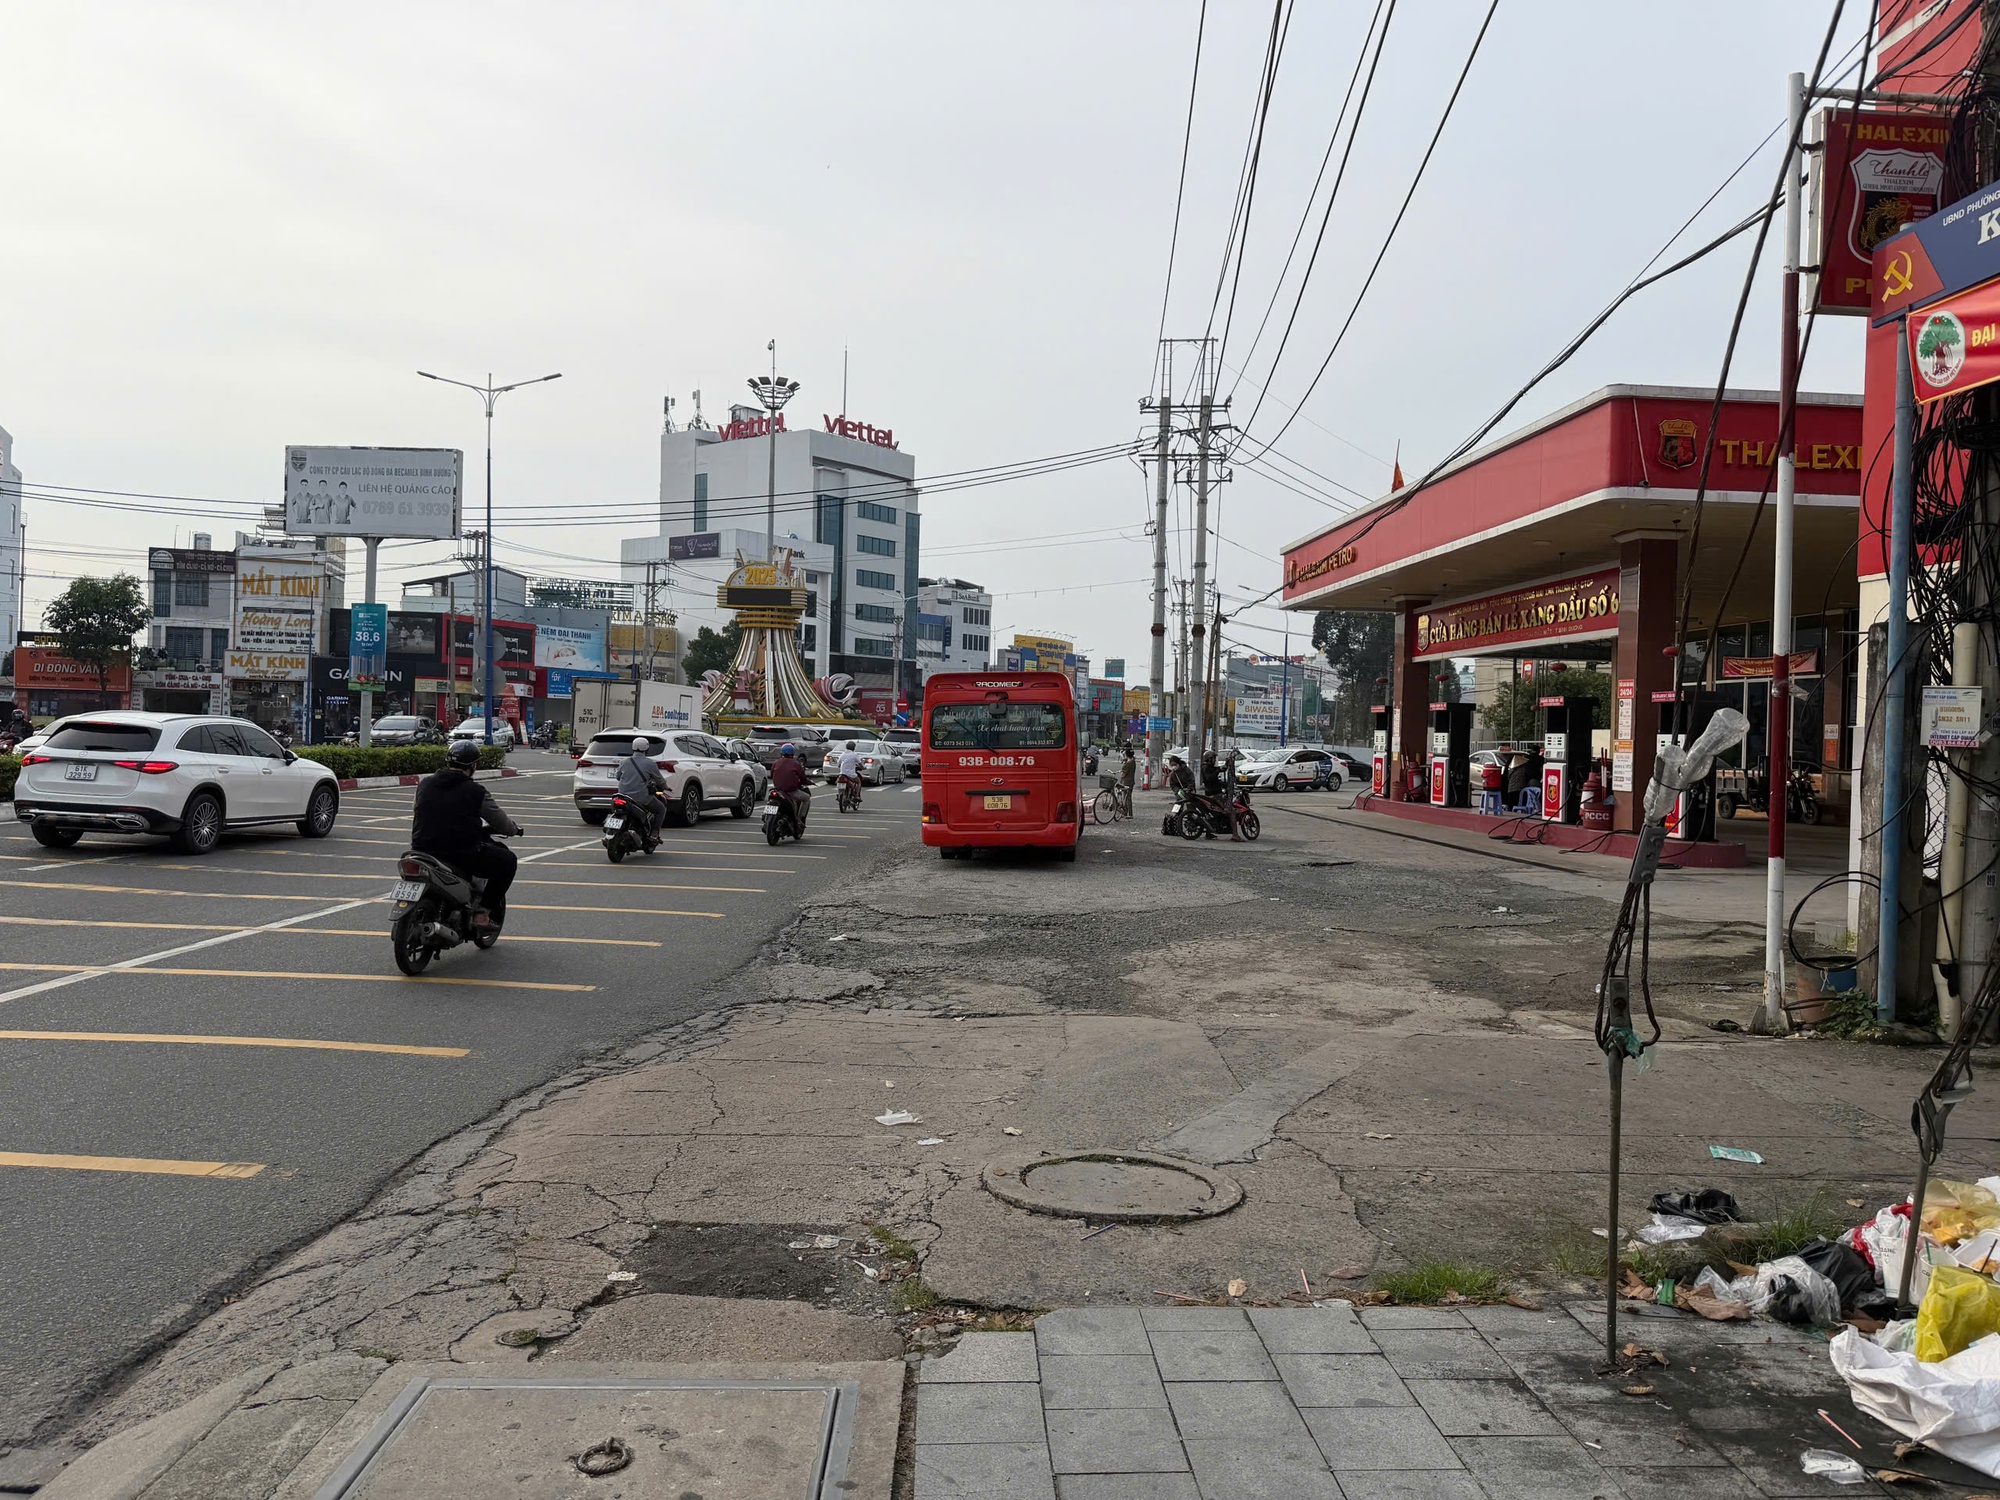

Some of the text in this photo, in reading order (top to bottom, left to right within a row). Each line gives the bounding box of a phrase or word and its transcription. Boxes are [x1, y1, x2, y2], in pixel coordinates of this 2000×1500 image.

[1942, 209, 1965, 226] UBND
[1972, 323, 1996, 347] ĐẠI
[309, 465, 324, 475] CÔNG
[325, 466, 331, 475] TY
[394, 468, 419, 477] BECAMEX
[358, 484, 451, 496] LIÊN HỆ QUẢNG CÁO
[1329, 546, 1354, 570] PETRO
[242, 565, 319, 598] MẮT KÍNH
[745, 567, 776, 585] 2025
[240, 612, 282, 630] Hoàng
[1429, 585, 1619, 644] CỬA HÀNG BÁN LẺ XĂNG DẦU SỐ 6
[355, 631, 380, 642] 38.6
[230, 652, 306, 669] MẮT KÍNH
[33, 663, 43, 672] DI
[47, 661, 77, 674] ĐỘNG
[329, 668, 402, 681] GAIN
[652, 705, 664, 716] ABA
[1244, 705, 1280, 714] BIWASE
[958, 756, 1035, 766] 93B-008.76
[1584, 811, 1610, 820] PCCC
